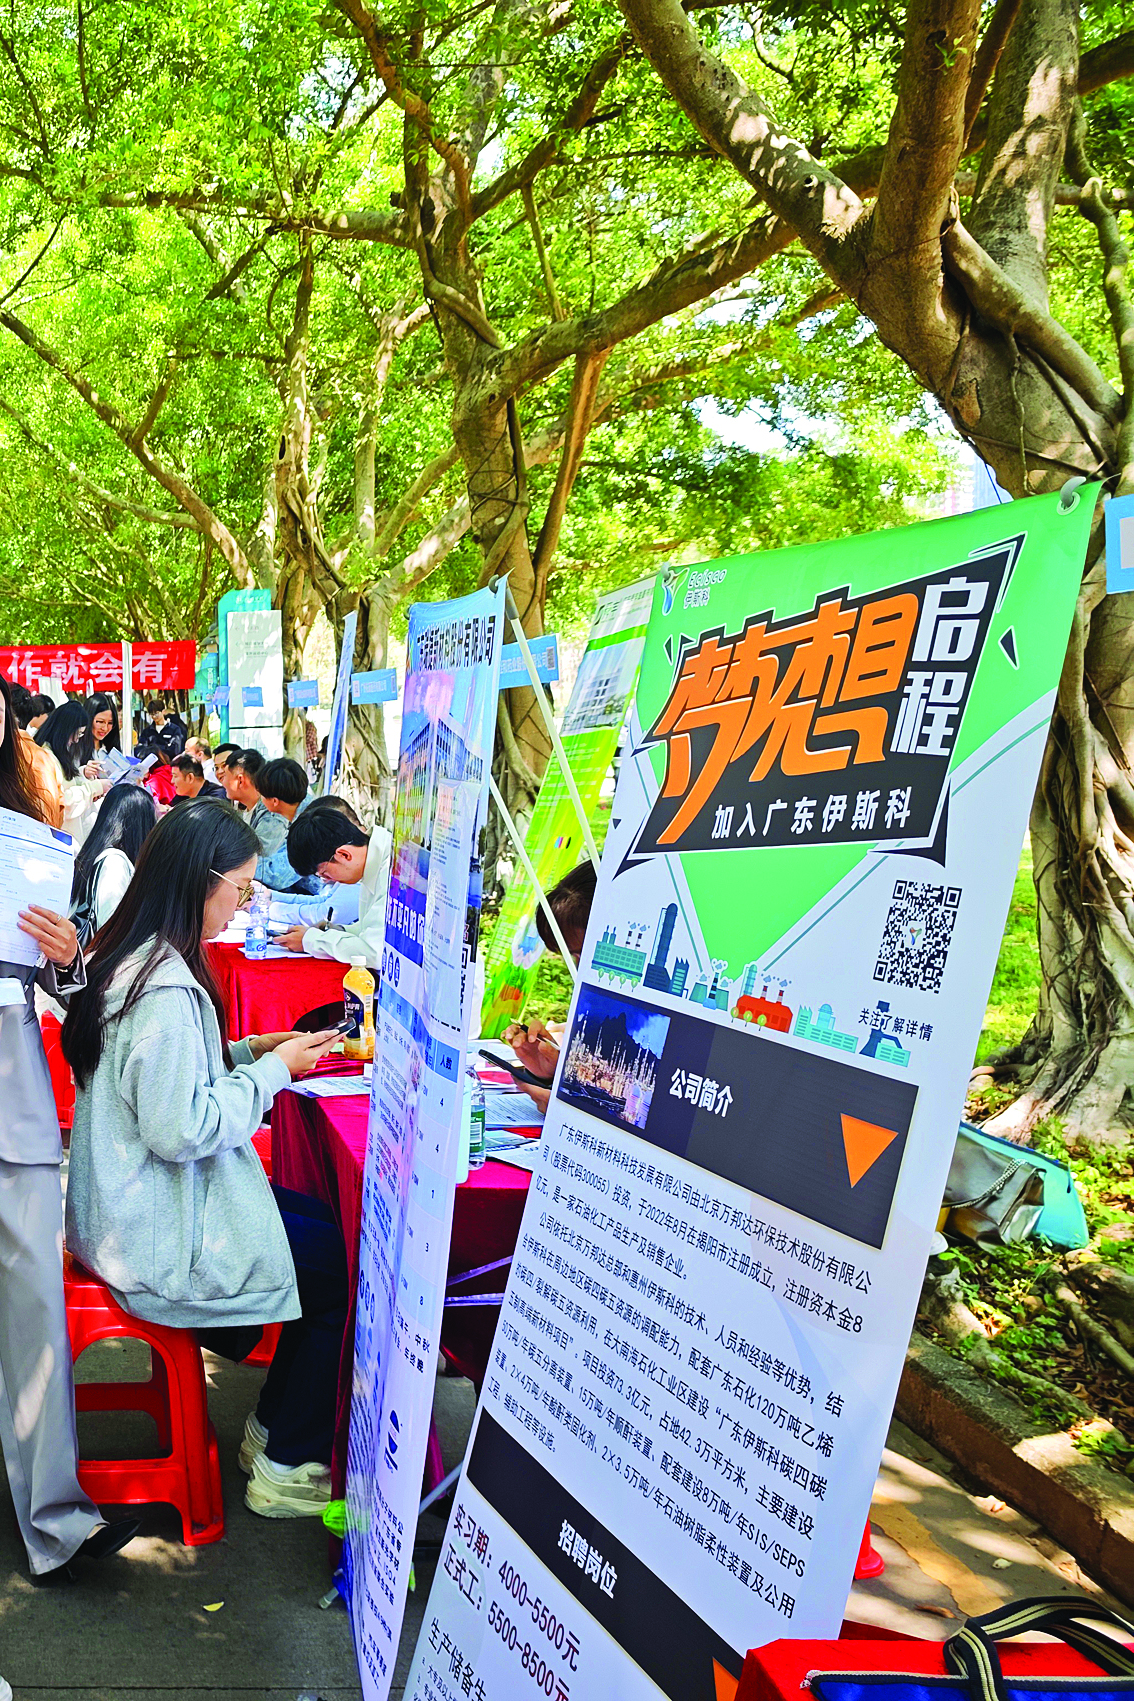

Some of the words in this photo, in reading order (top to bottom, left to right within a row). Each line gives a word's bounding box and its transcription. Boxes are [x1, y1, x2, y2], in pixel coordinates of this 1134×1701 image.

[683, 586, 711, 610] 伊斯科
[890, 576, 990, 757] 启程
[652, 592, 921, 845] 梦想
[710, 786, 912, 840] 加入广东伊斯科
[857, 1007, 934, 1043] 关注了解详情
[669, 1067, 734, 1118] 公司简介
[557, 1518, 618, 1600] 招聘岗位
